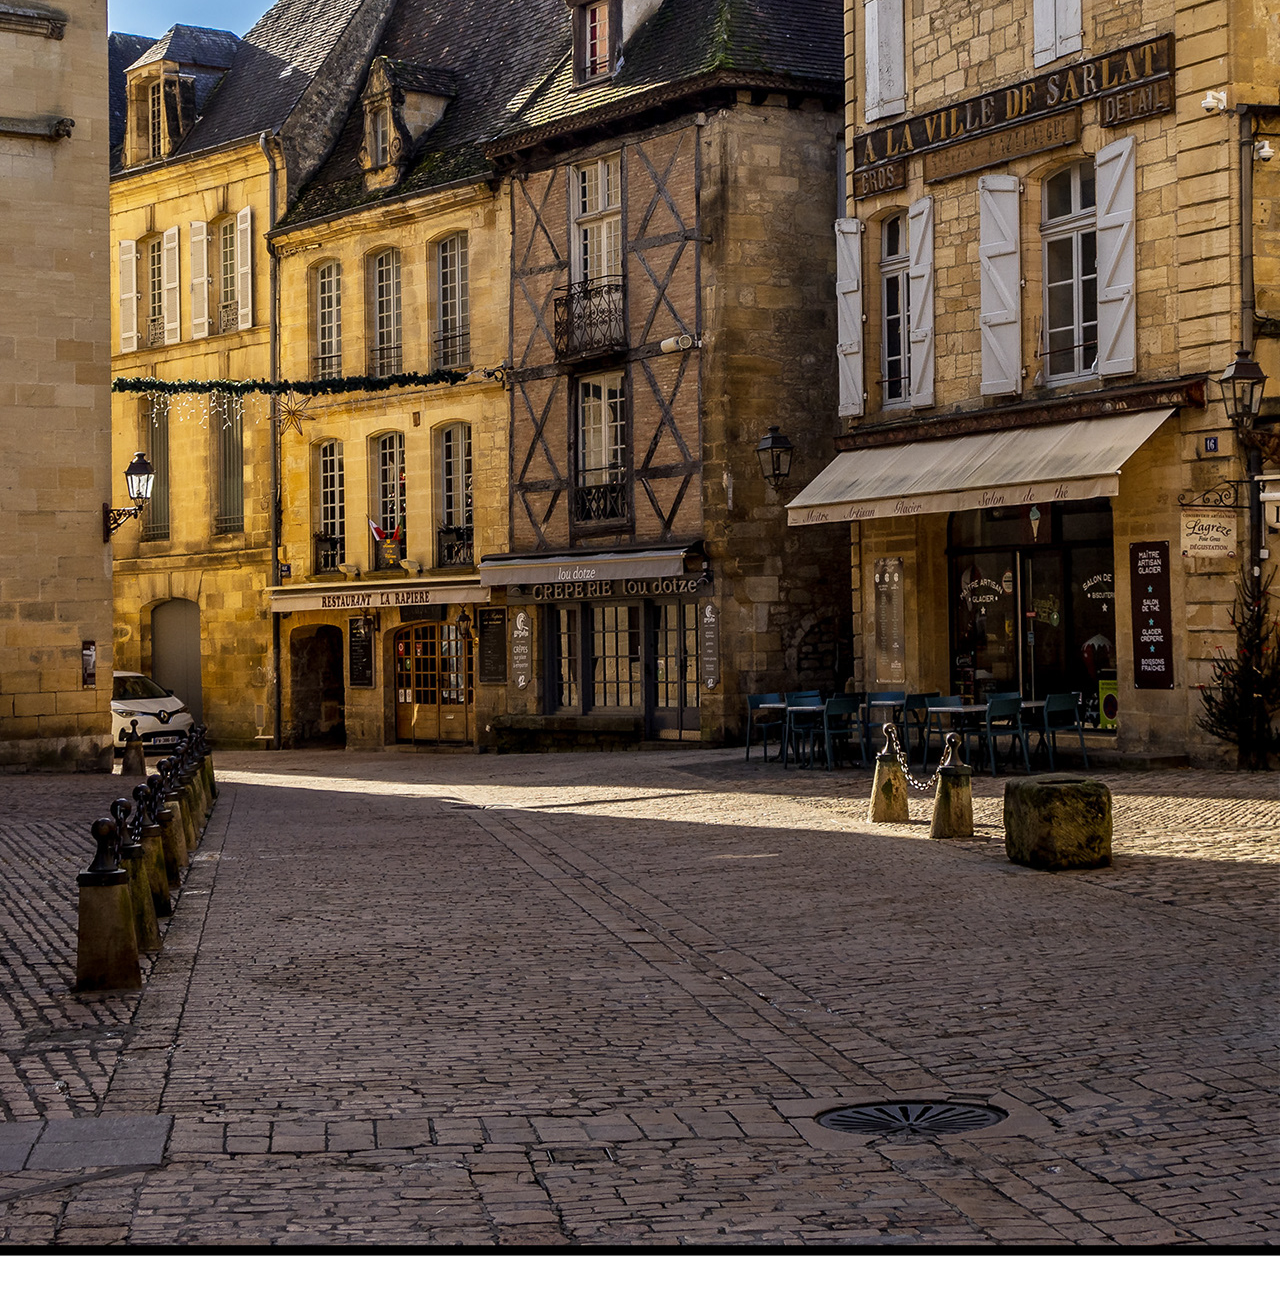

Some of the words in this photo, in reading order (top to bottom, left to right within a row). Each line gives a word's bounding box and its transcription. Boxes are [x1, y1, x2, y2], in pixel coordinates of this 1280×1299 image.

[885, 123, 914, 156] LA
[924, 96, 996, 143] VILLE
[1046, 44, 1157, 107] SARLAT
[861, 165, 895, 194] GROS
[1207, 438, 1215, 450] 16
[843, 506, 876, 520] Artisan
[893, 501, 922, 515] Glacier
[978, 491, 1005, 506] Salon
[1022, 487, 1035, 502] de
[1054, 484, 1069, 500] thé
[1185, 518, 1232, 537] Lagrèze
[1138, 550, 1160, 559] MAÎTRE
[1138, 559, 1161, 567] ARTISAN
[1138, 566, 1162, 574] GLACIER
[558, 567, 571, 580] lou
[573, 566, 596, 579] dotze
[622, 579, 648, 595] lou
[652, 577, 697, 594] dotze
[1082, 574, 1103, 591] SALON
[1103, 573, 1113, 582] DE
[321, 594, 372, 608] RESTAURANT
[380, 592, 390, 605] LA
[395, 591, 430, 604] RAPIERE
[972, 594, 994, 603] GLACIER
[1142, 628, 1162, 636] GLACIER
[1141, 658, 1165, 666] BOISSONS
